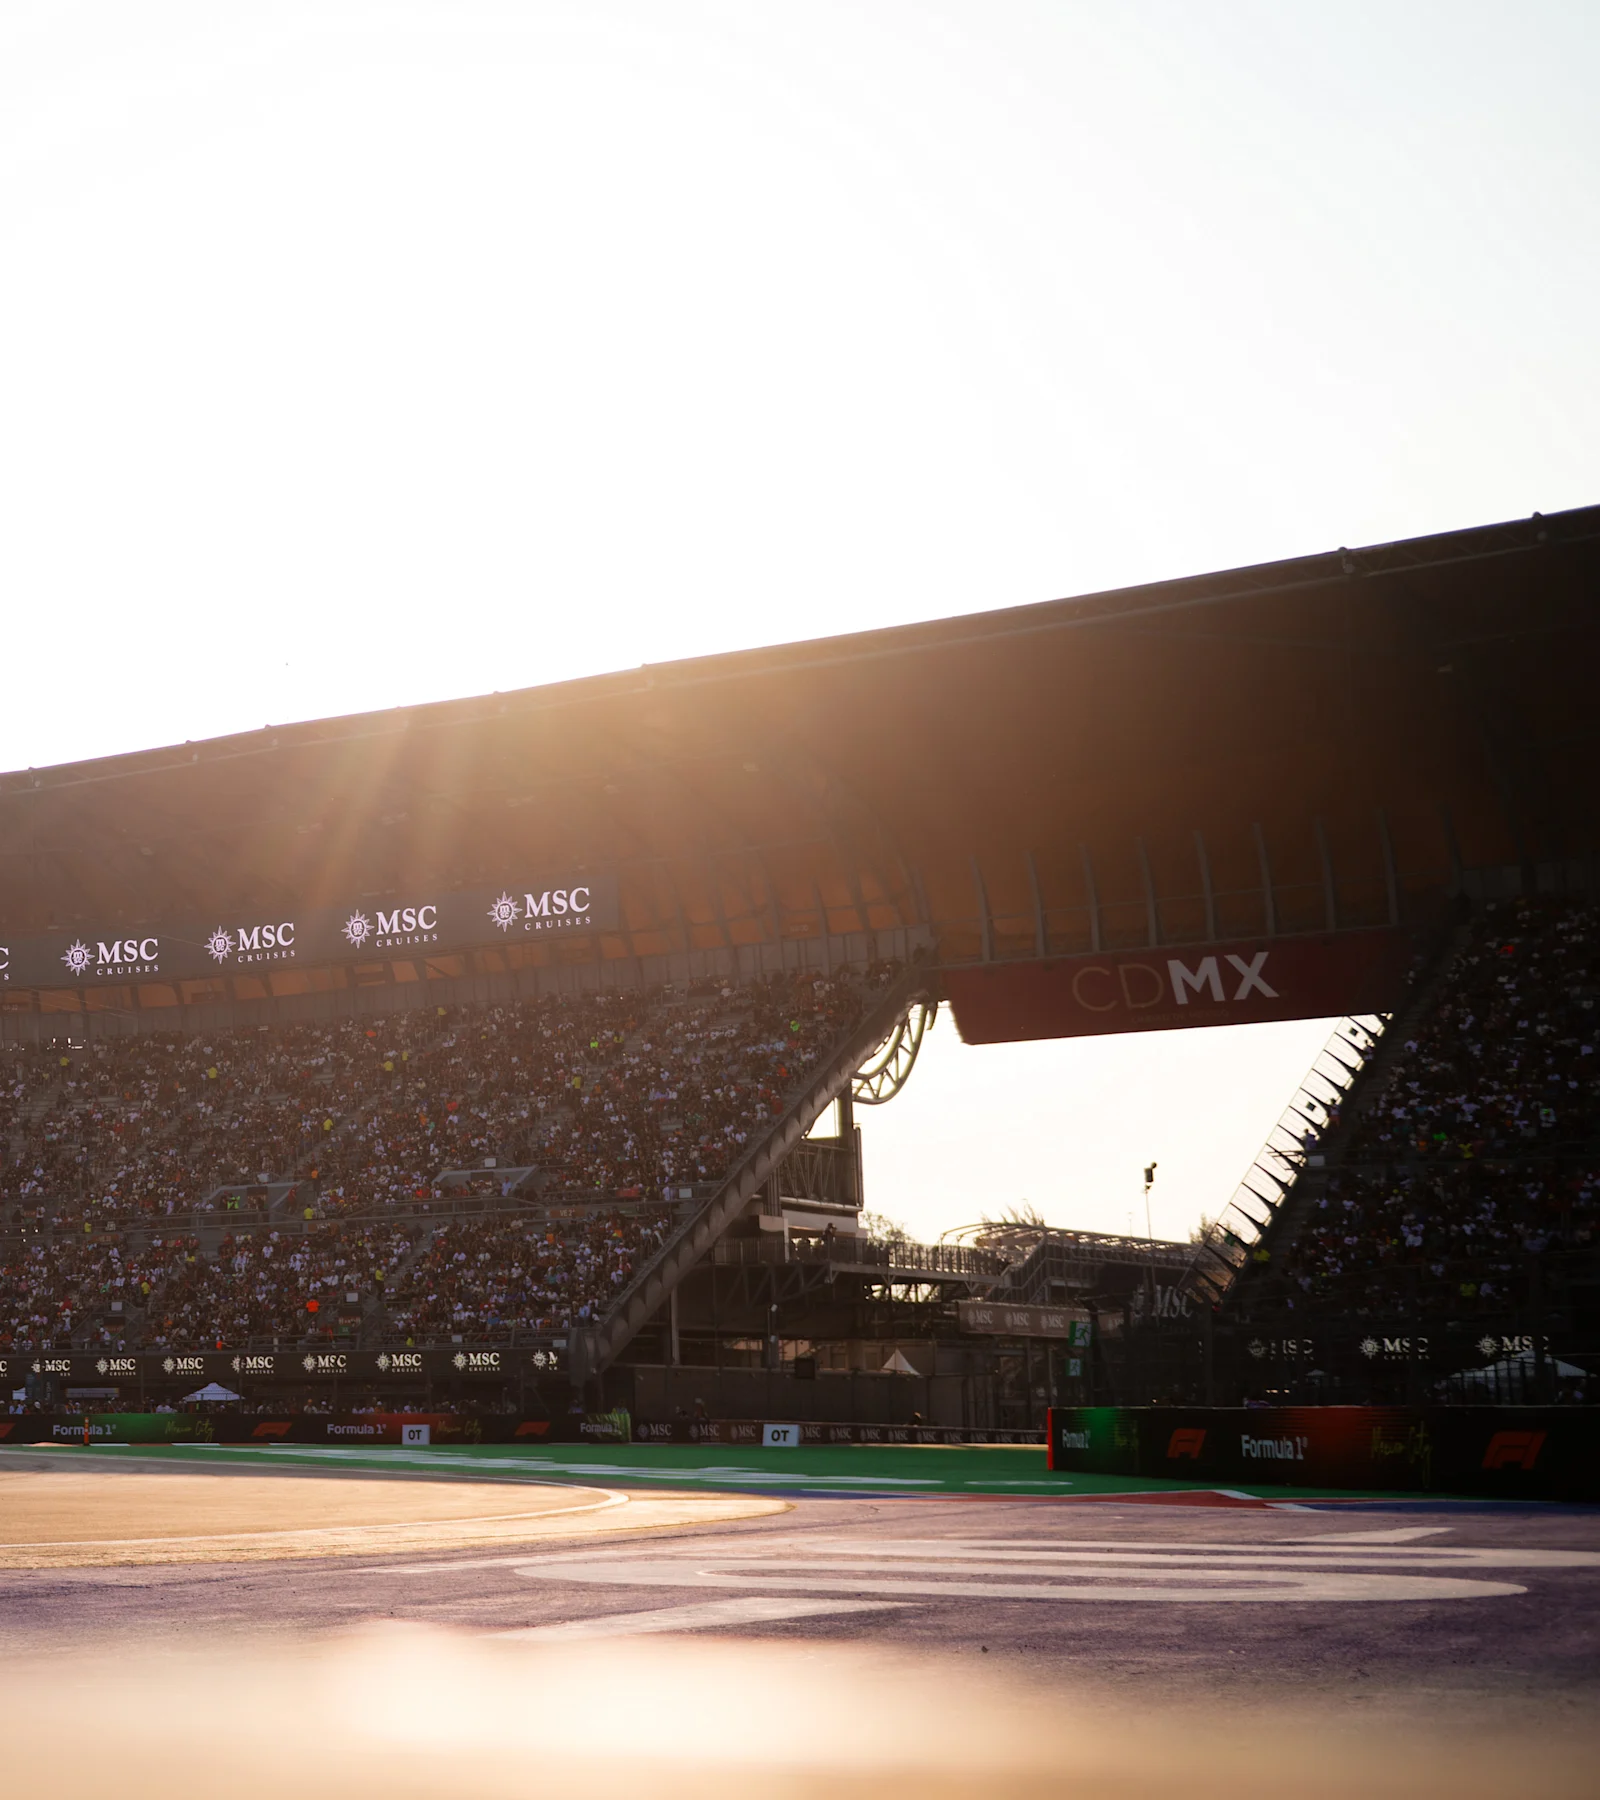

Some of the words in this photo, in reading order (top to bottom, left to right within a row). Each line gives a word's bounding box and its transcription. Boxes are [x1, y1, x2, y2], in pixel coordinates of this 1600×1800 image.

[524, 887, 590, 918] MSC
[375, 905, 437, 935] MSC
[524, 916, 591, 931] CRUISES
[237, 922, 295, 951] MSC
[376, 933, 438, 947] CRUISES
[97, 938, 159, 964] MSC
[238, 949, 295, 963] CRUISES
[97, 964, 159, 976] CRUISES
[1072, 951, 1279, 1012] CDMX
[109, 1359, 135, 1370] MSC
[176, 1357, 204, 1370] MSC
[246, 1356, 274, 1368] MSC
[317, 1355, 347, 1367] MSC
[392, 1353, 422, 1366] MSC
[469, 1352, 500, 1365] MSC
[45, 1360, 70, 1372] MSC
[327, 1424, 374, 1435] Formula
[408, 1430, 421, 1440] OT
[650, 1424, 672, 1436] MSC
[700, 1424, 720, 1436] MSC
[738, 1425, 756, 1437] MSC
[771, 1430, 789, 1441] OT
[1241, 1434, 1294, 1460] Formula
